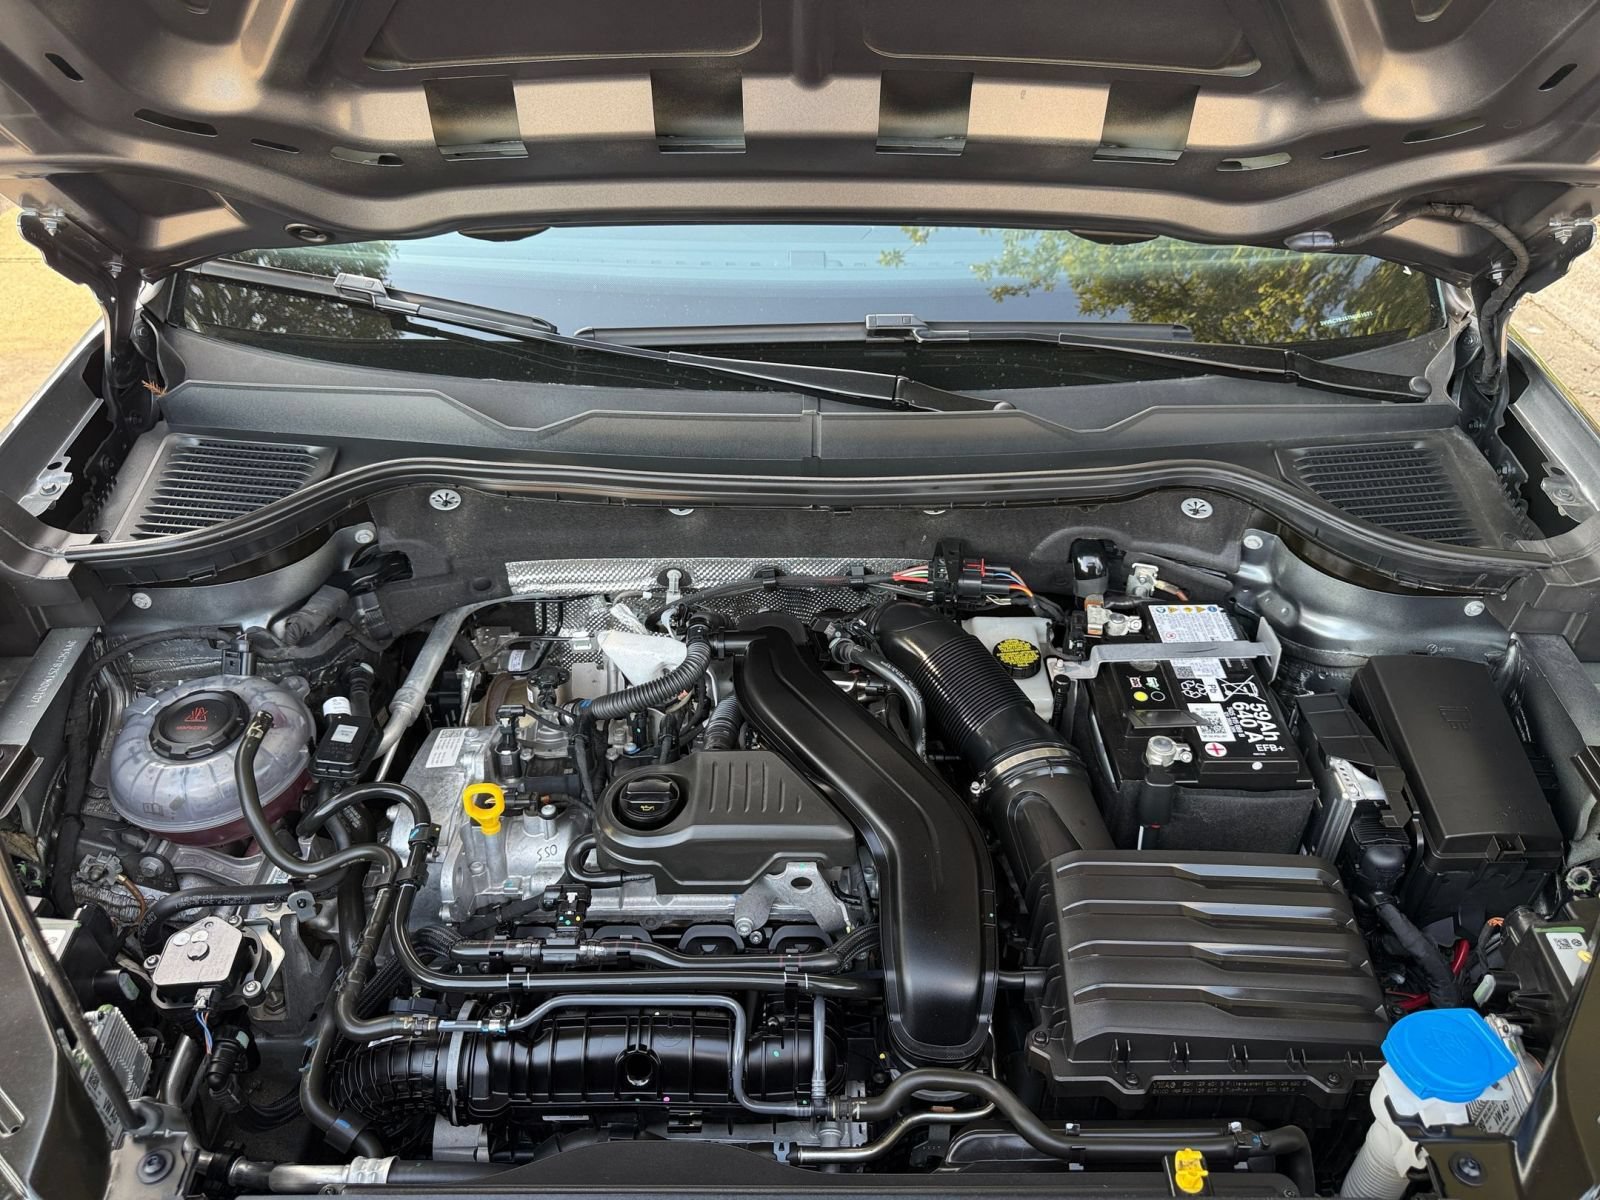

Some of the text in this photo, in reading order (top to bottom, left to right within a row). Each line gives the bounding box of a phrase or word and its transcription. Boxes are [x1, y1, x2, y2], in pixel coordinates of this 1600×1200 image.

[1232, 702, 1258, 728] 640
[1250, 703, 1280, 741] 59Ah
[1244, 731, 1265, 743] A
[1256, 744, 1285, 752] EFB+
